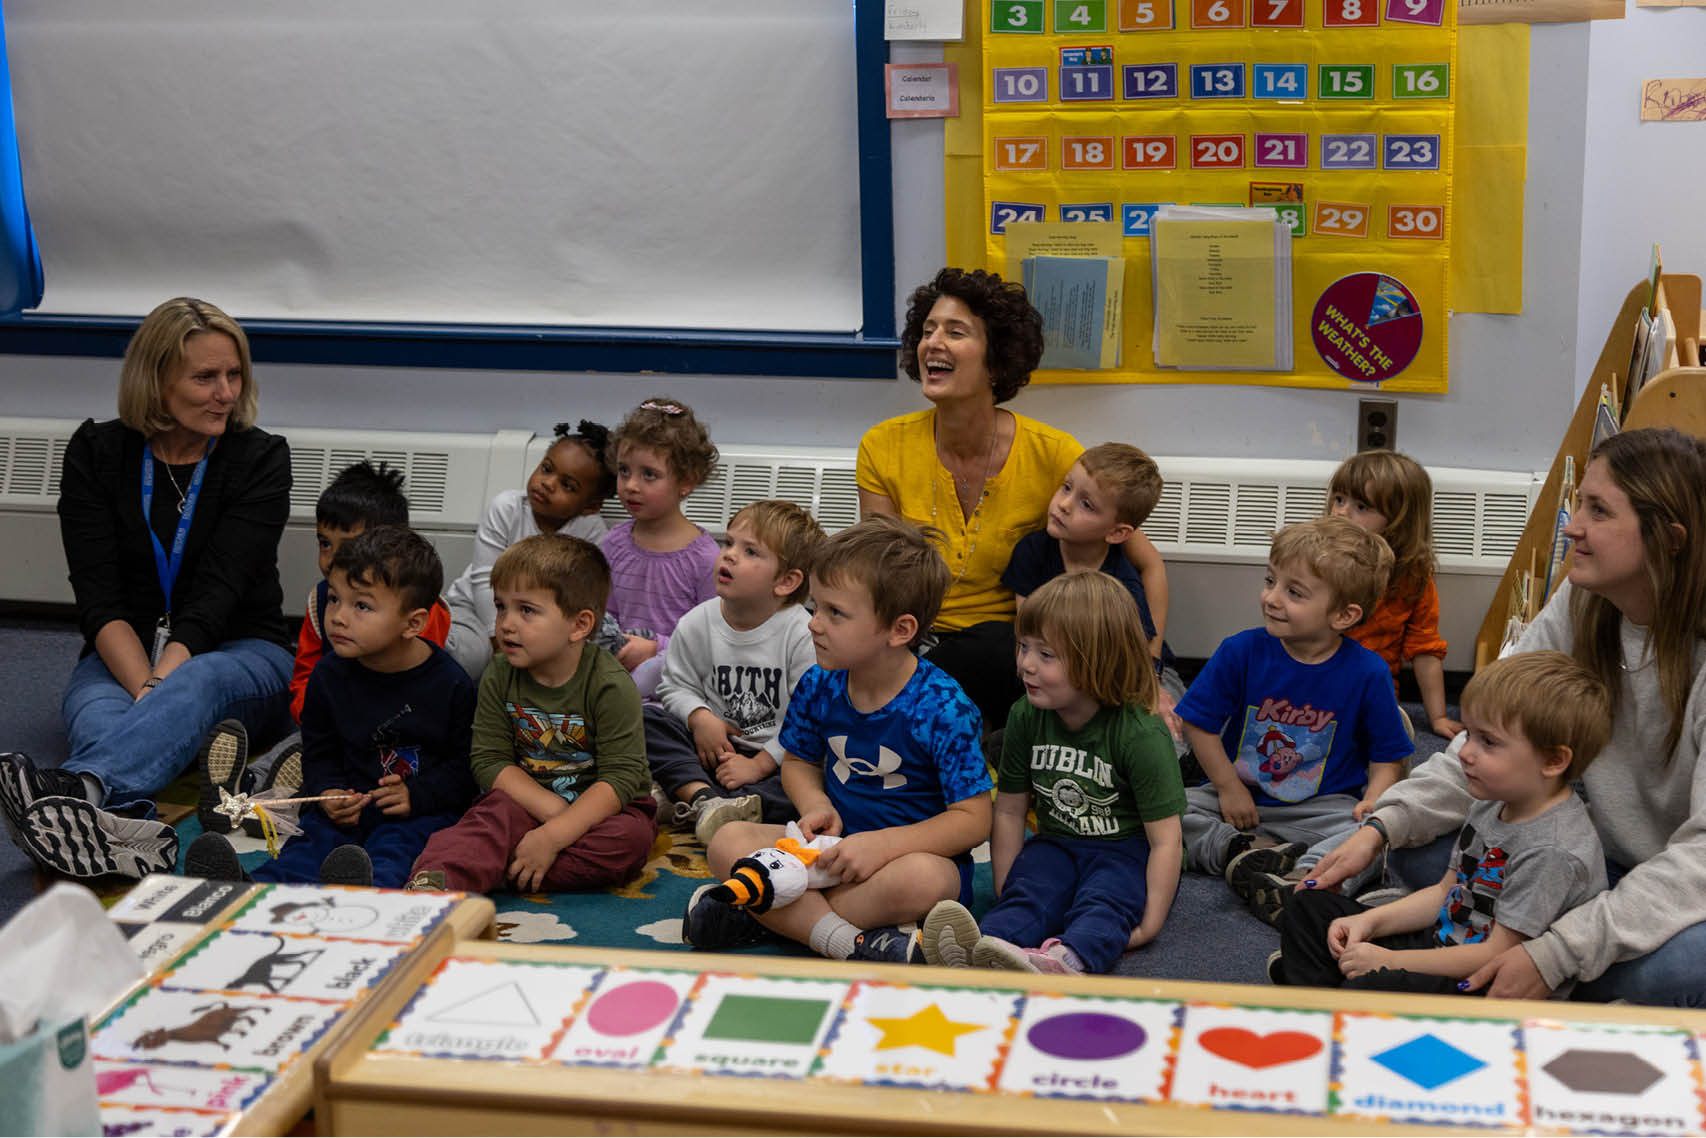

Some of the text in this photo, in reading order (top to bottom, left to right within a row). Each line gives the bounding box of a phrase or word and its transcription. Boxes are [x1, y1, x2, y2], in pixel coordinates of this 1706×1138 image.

[1007, 0, 1428, 26] 3 4 5 6 7 8 9
[1004, 69, 1439, 96] 10 11 12 13 14 15 16
[1005, 139, 1433, 164] 17 18 19 20 21 22 23
[1129, 210, 1152, 229] 2
[1320, 208, 1364, 230] 29
[1394, 210, 1438, 233] 30
[1318, 320, 1376, 376] WEATHER?
[1325, 304, 1370, 348] WHAT'S
[1368, 345, 1393, 371] THE
[712, 665, 782, 709] AITH
[1255, 696, 1336, 732] Kirby
[134, 885, 178, 911] White
[182, 885, 233, 917] Blanco
[324, 958, 378, 989] black
[252, 1015, 315, 1057] brown
[574, 1046, 640, 1059] oval
[695, 1053, 799, 1067] square
[874, 1063, 933, 1076] star
[1032, 1073, 1118, 1089] circle
[206, 1076, 251, 1108] pink
[1209, 1083, 1296, 1102] heart
[1353, 1094, 1505, 1117] diamond
[1534, 1103, 1687, 1129] hexagon
